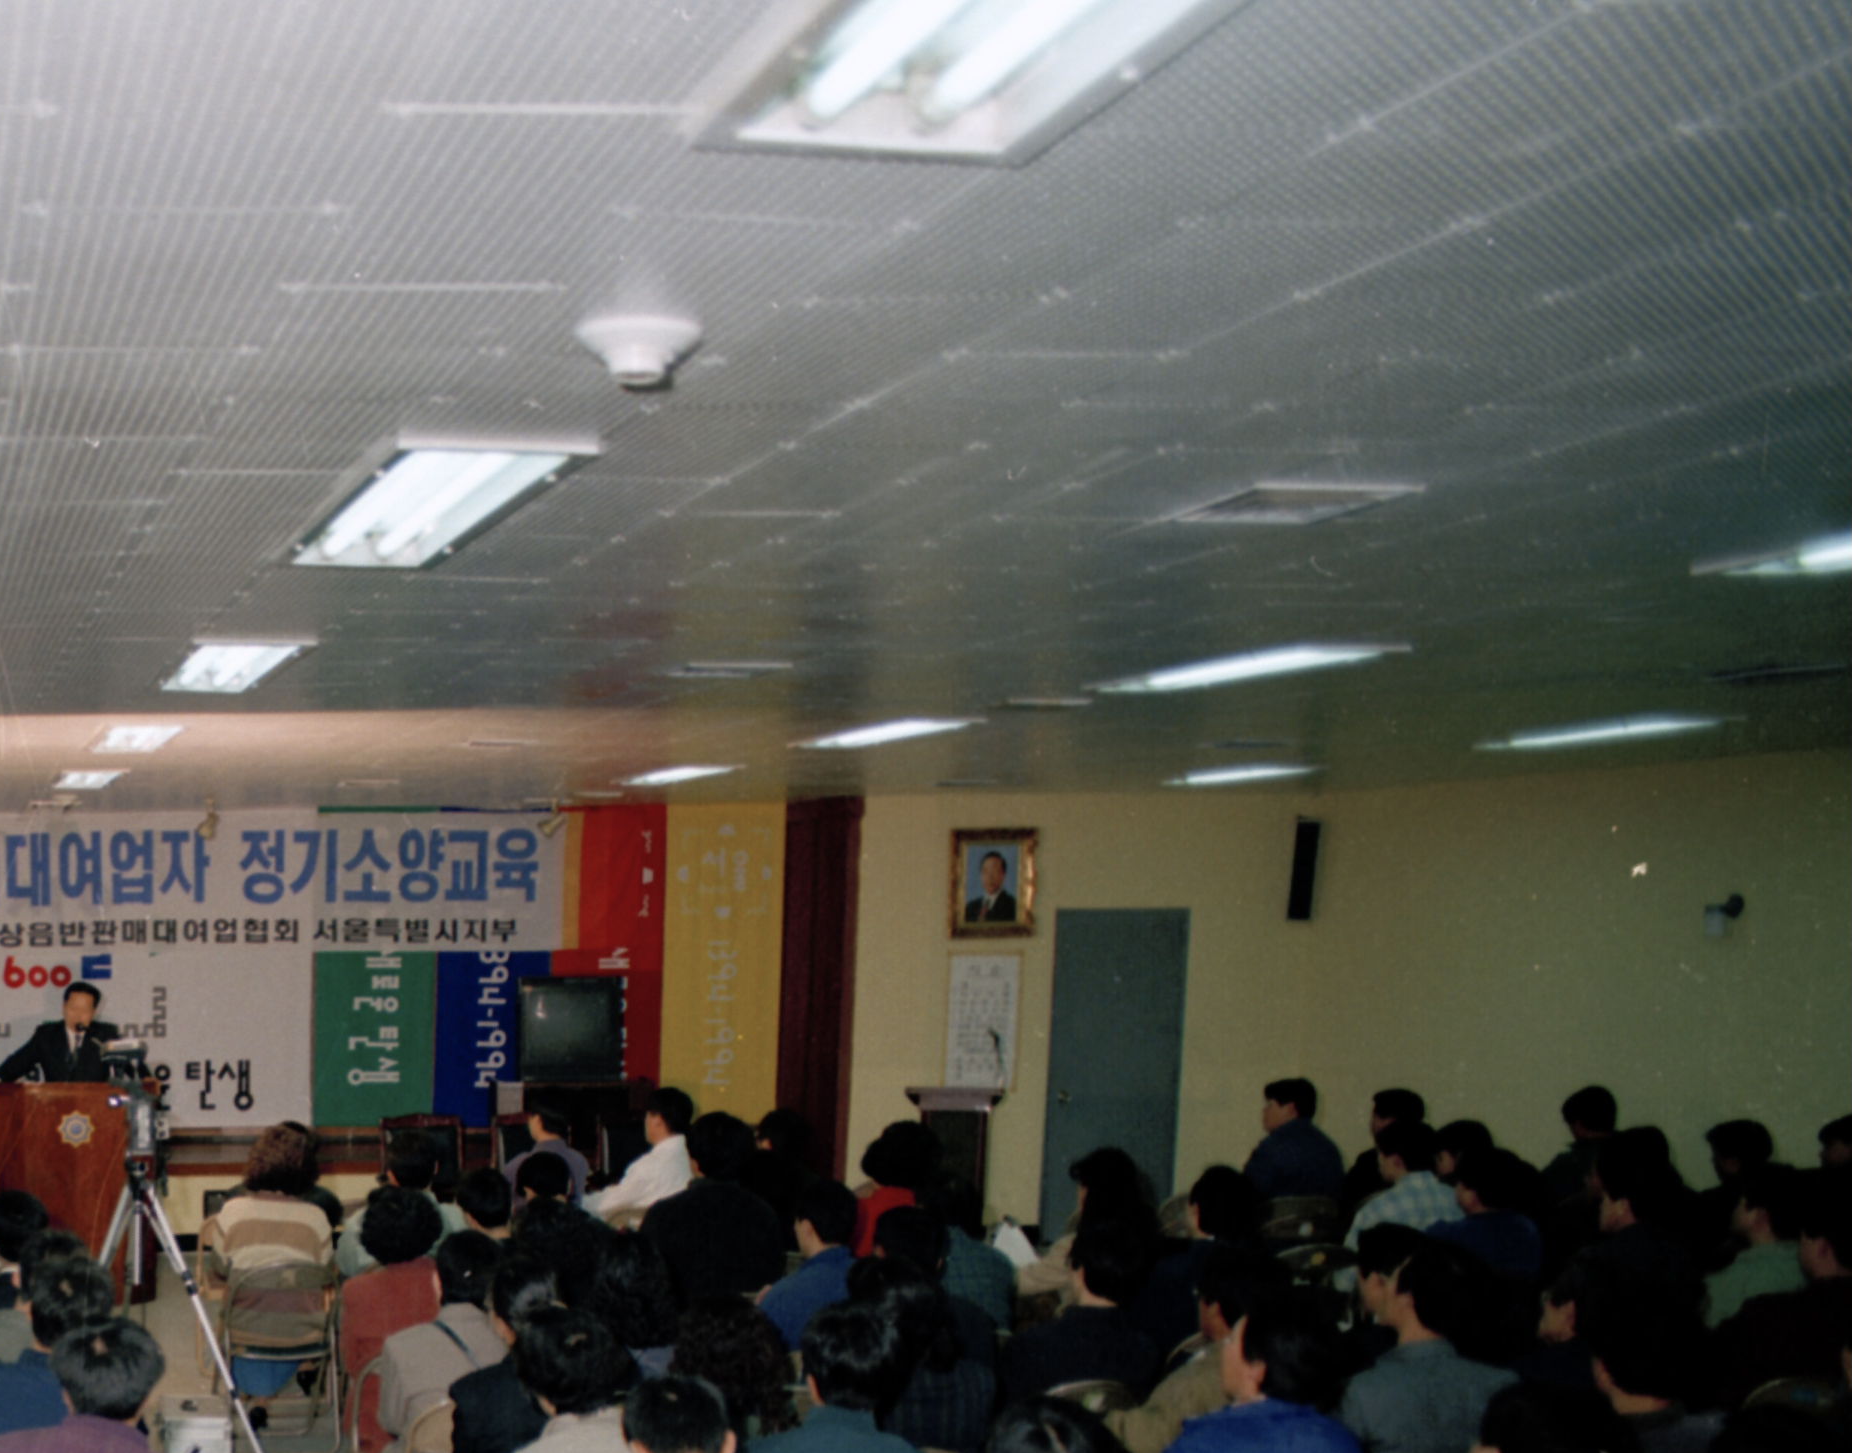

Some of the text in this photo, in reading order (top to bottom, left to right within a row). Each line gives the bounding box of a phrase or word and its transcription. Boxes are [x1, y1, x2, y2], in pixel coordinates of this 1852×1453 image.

[239, 828, 539, 904] 정기소양교육
[313, 917, 518, 944] 서울특별시지부
[346, 1026, 401, 1086] 탄생
[185, 1059, 254, 1110] 탄생
